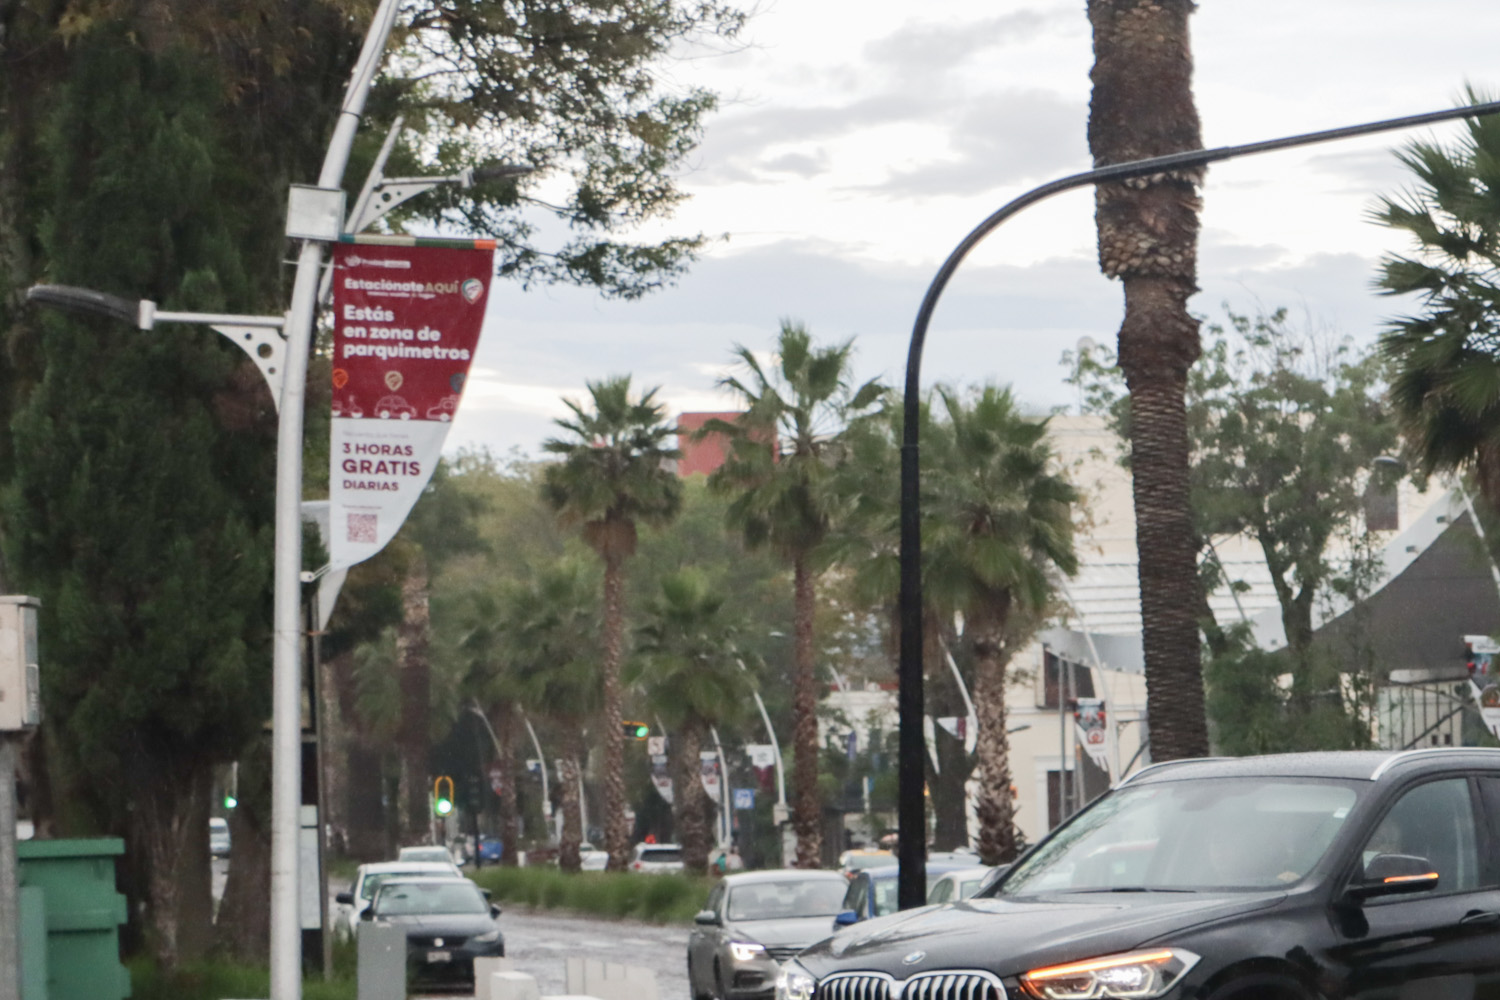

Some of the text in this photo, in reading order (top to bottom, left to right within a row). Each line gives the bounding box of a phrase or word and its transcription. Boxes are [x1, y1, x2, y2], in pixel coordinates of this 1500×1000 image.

[343, 305, 394, 321] Estás
[343, 326, 441, 341] en zona de
[343, 443, 413, 456] 3 HORAS
[342, 459, 421, 476] GRATIS
[343, 480, 399, 491] DIARIAS
